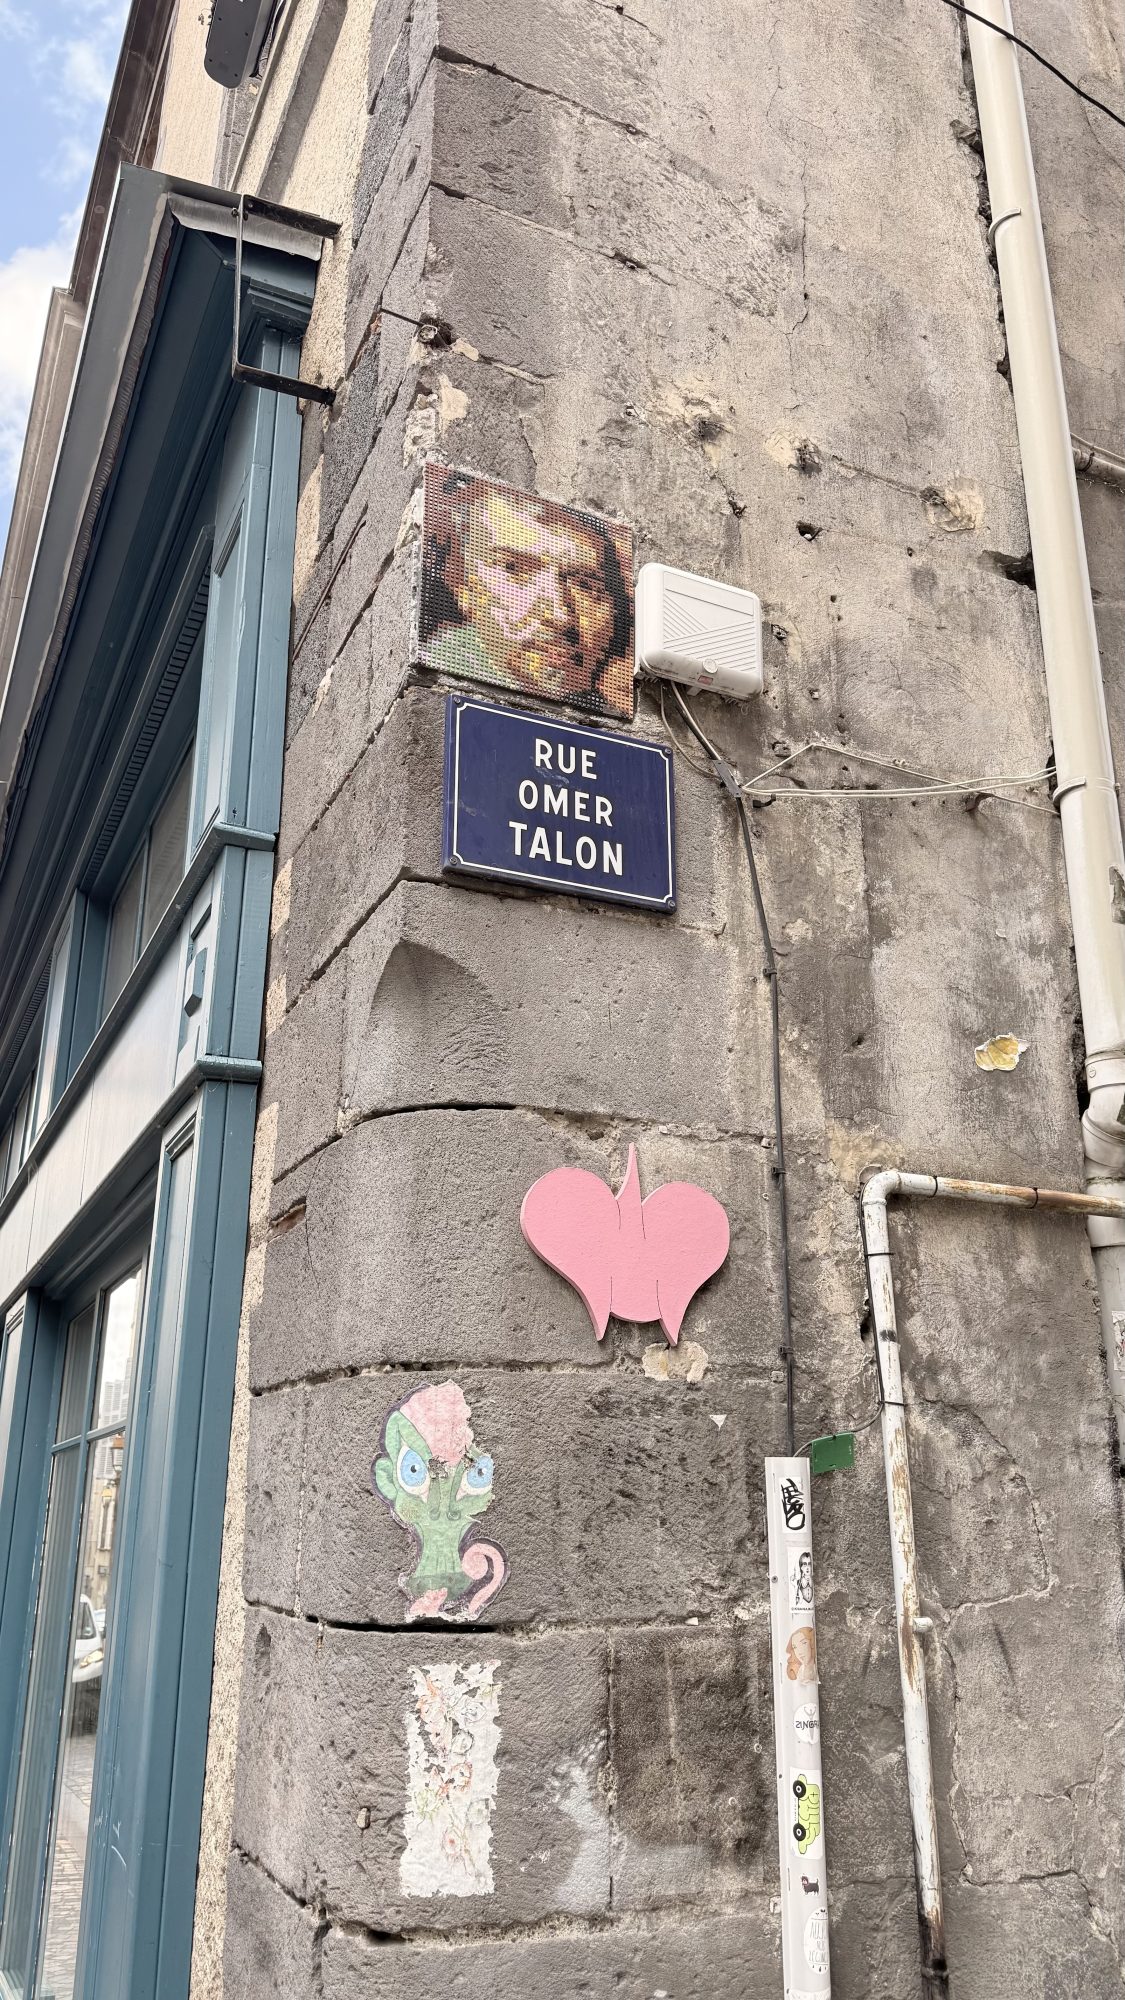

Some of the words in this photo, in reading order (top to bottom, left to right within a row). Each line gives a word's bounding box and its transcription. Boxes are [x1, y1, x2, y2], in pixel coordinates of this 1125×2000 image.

[535, 738, 597, 780] RUE
[518, 779, 613, 827] OMER
[508, 821, 623, 876] TALON
